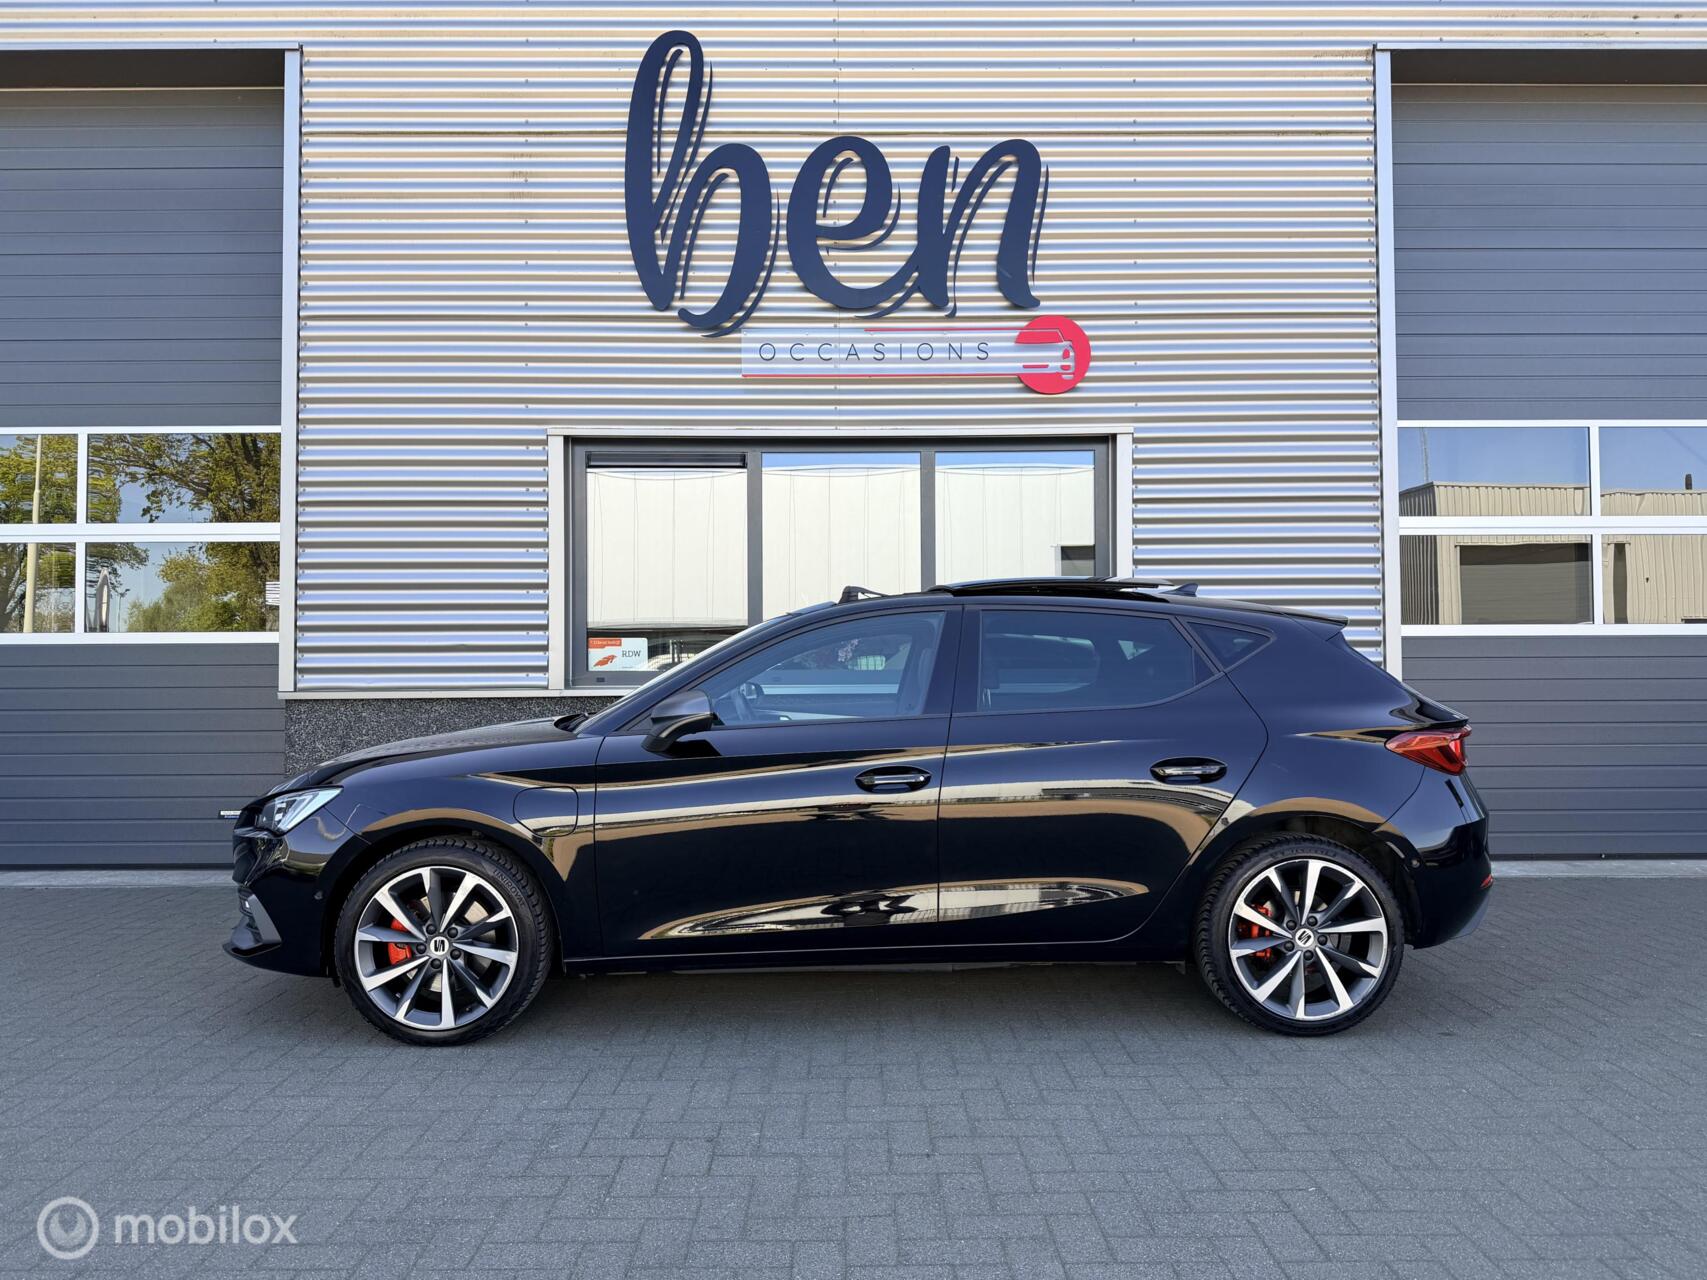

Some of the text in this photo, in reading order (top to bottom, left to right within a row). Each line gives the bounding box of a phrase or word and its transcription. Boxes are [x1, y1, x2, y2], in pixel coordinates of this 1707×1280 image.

[624, 29, 1049, 338] ben
[758, 342, 989, 361] OCCASIONS
[621, 650, 641, 658] RDW
